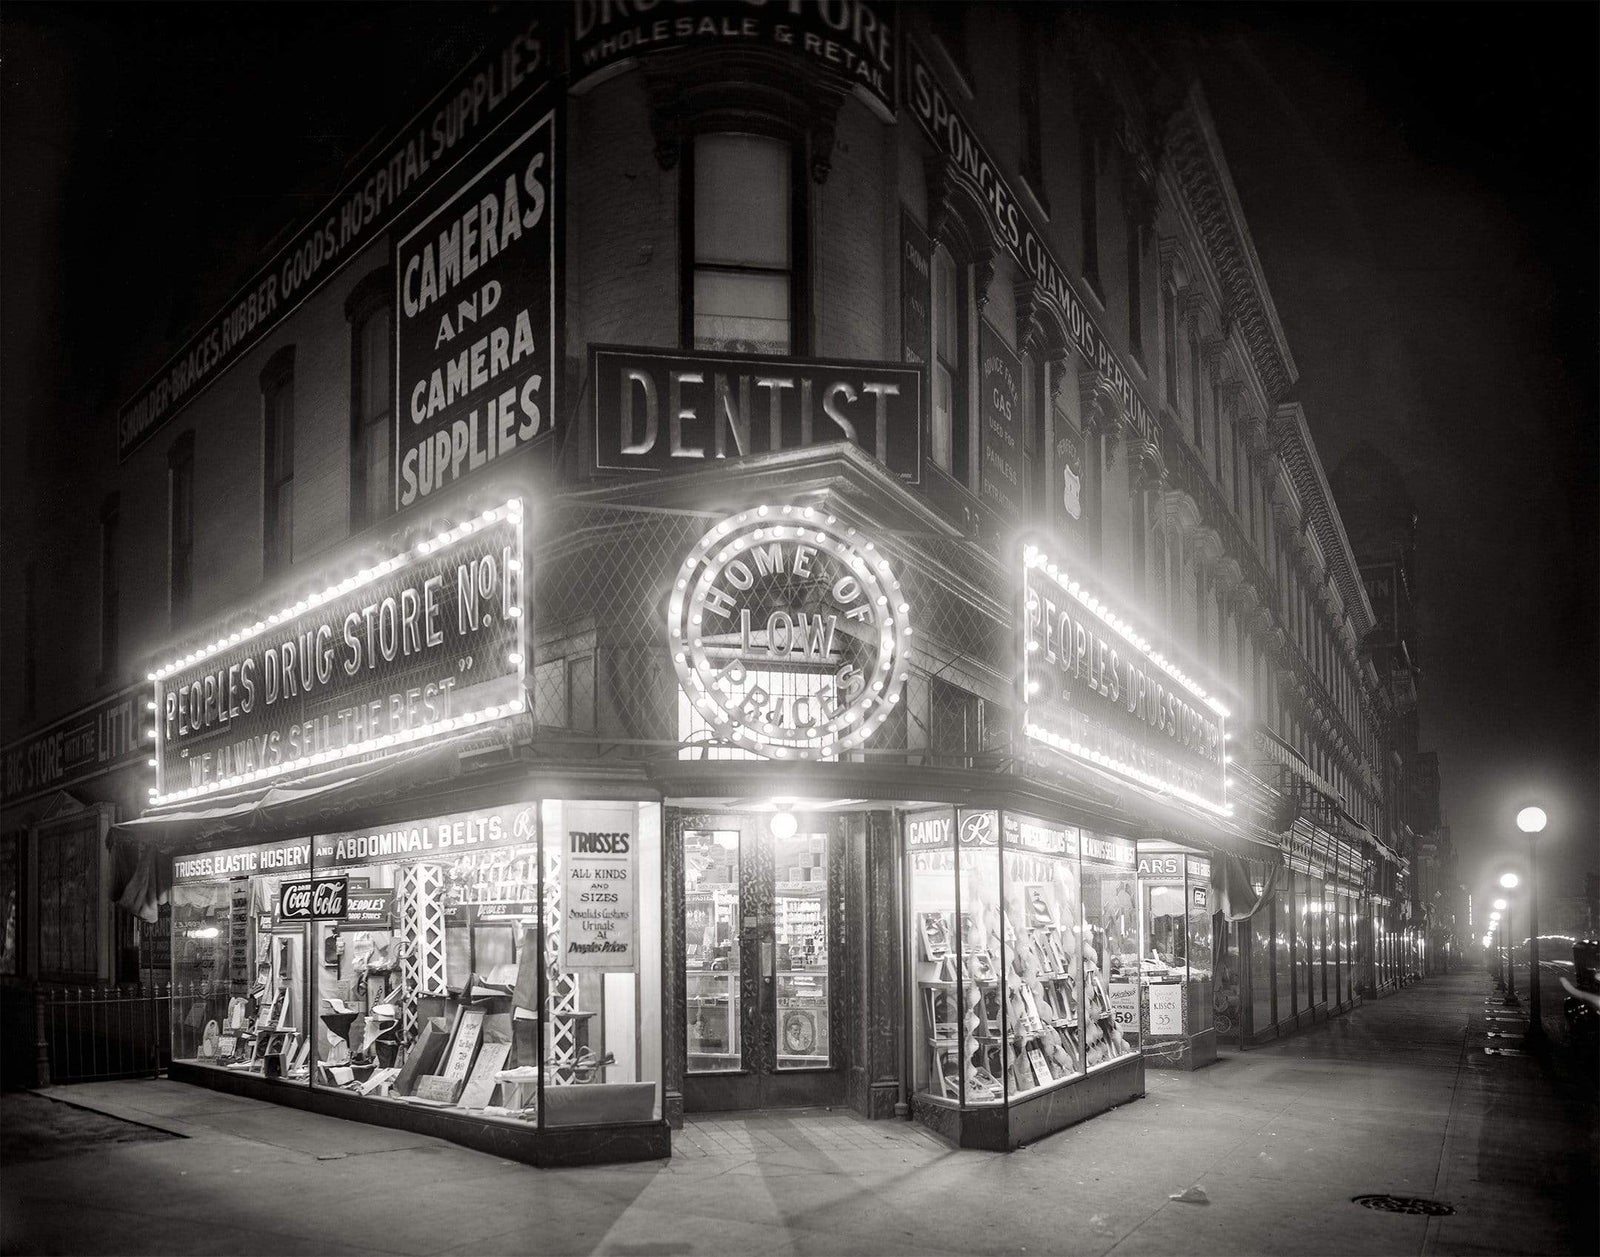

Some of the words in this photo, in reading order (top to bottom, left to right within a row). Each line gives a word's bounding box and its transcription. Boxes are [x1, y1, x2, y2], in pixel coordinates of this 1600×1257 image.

[581, 16, 761, 66] WHOLESALE
[774, 24, 794, 45] &
[804, 31, 891, 101] RETAIL
[340, 128, 431, 249] HOSPITAL
[432, 16, 541, 160] SUPPLIES
[403, 152, 545, 318] CAMERAS
[435, 280, 502, 349] AND
[410, 310, 535, 424] CAMERA
[1098, 338, 1161, 448] PERFUMES
[620, 367, 900, 466] DENTIST
[993, 388, 1012, 421] GAS
[402, 375, 542, 506] SUPPLIES
[701, 542, 818, 619] HOME
[831, 575, 874, 624] OF
[165, 657, 255, 741] PEOPLES
[264, 624, 334, 705] DRUG
[343, 575, 444, 676] STORE
[740, 607, 837, 660] LOW
[1025, 586, 1121, 703] PEOPLES
[1126, 662, 1166, 731] DRUG
[714, 658, 866, 729] PRICES
[27, 731, 64, 788] STORE
[216, 731, 281, 784] ALWAYS
[289, 714, 333, 760] SELL
[337, 699, 382, 747] THE
[174, 857, 214, 878] TRUSSES,
[214, 852, 258, 874] ELASTIC
[260, 844, 312, 869] HOSIERY
[316, 846, 334, 857] AND
[335, 827, 433, 860] ABDOMINAL
[438, 815, 507, 848] BELTS.
[568, 831, 631, 854] TRUSSES
[909, 818, 951, 844] CANDY
[570, 868, 592, 879] ALL
[595, 868, 627, 880] KINDS
[580, 892, 619, 903] SIZES
[582, 920, 615, 931] Urinals
[601, 940, 629, 953] Prices
